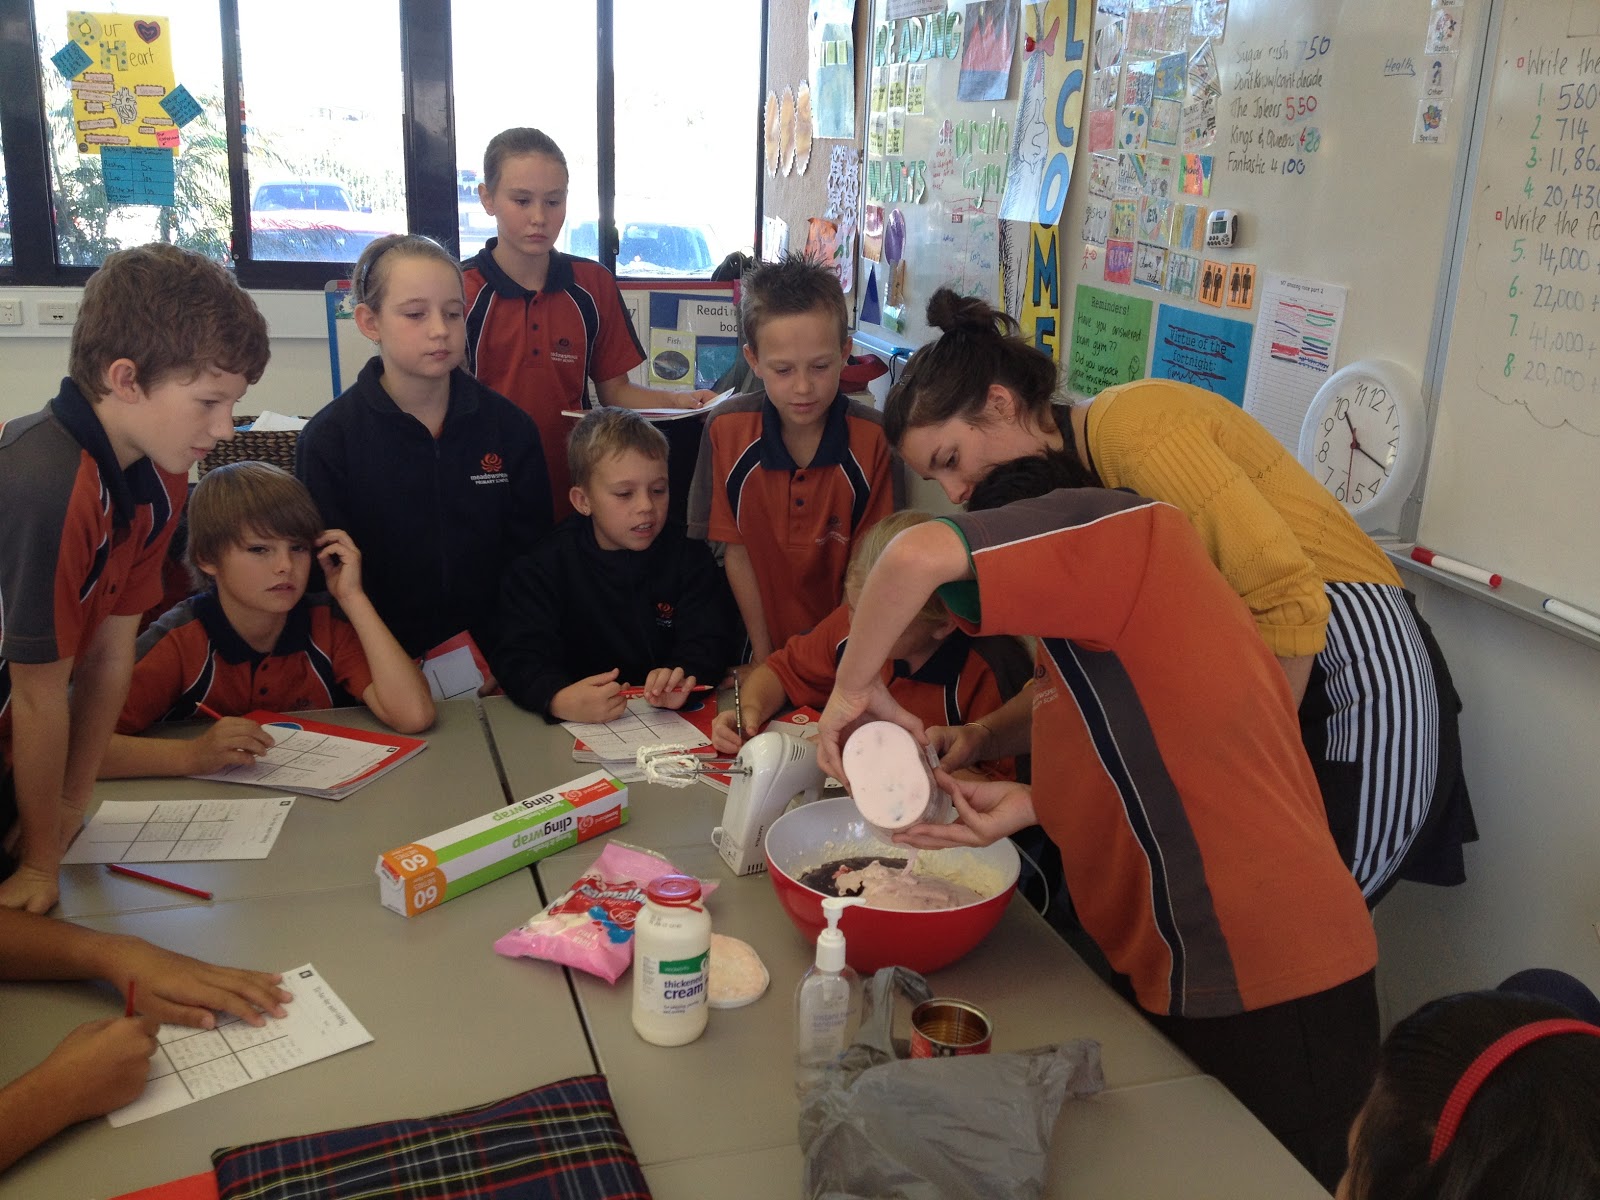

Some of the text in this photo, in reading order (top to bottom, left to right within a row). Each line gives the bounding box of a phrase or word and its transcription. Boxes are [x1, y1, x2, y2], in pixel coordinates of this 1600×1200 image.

[875, 12, 961, 66] READING
[100, 40, 154, 71] Heart
[1384, 57, 1414, 73] Health
[1527, 47, 1600, 76] Write the
[1230, 96, 1317, 120] The Jokers 550
[1557, 83, 1600, 110] 580
[956, 108, 1009, 160] Brain
[1231, 125, 1253, 153] Kings
[1556, 118, 1588, 144] 714
[1228, 151, 1265, 174] Fantastic
[1271, 159, 1278, 172] 4
[868, 160, 927, 204] MATHS
[1504, 205, 1546, 233] Write
[1556, 210, 1578, 238] the
[1539, 243, 1589, 276] 14,000
[697, 305, 738, 316] Readin
[1091, 296, 1130, 316] Reminders!
[1533, 284, 1584, 314] 22,000
[1078, 312, 1142, 342] Have you answered
[1529, 321, 1584, 352] 41,000
[1092, 341, 1107, 356] gym
[1170, 329, 1227, 355] Virtue of the
[1173, 350, 1217, 372] fortnight:
[1354, 384, 1368, 406] 11
[1369, 387, 1386, 411] 12
[1334, 398, 1349, 421] 10
[1386, 404, 1397, 424] 1
[1324, 418, 1334, 437] 9
[1318, 442, 1330, 463] 8
[1324, 466, 1334, 485] 7
[1335, 482, 1346, 501] 6
[1352, 483, 1366, 503] 5
[1368, 478, 1381, 498] 4
[492, 794, 554, 822] clingwrap
[512, 816, 572, 848] clingwrap
[401, 854, 429, 871] 60
[414, 885, 438, 909] 60
[664, 974, 703, 988] thickened
[664, 983, 703, 1000] cream
